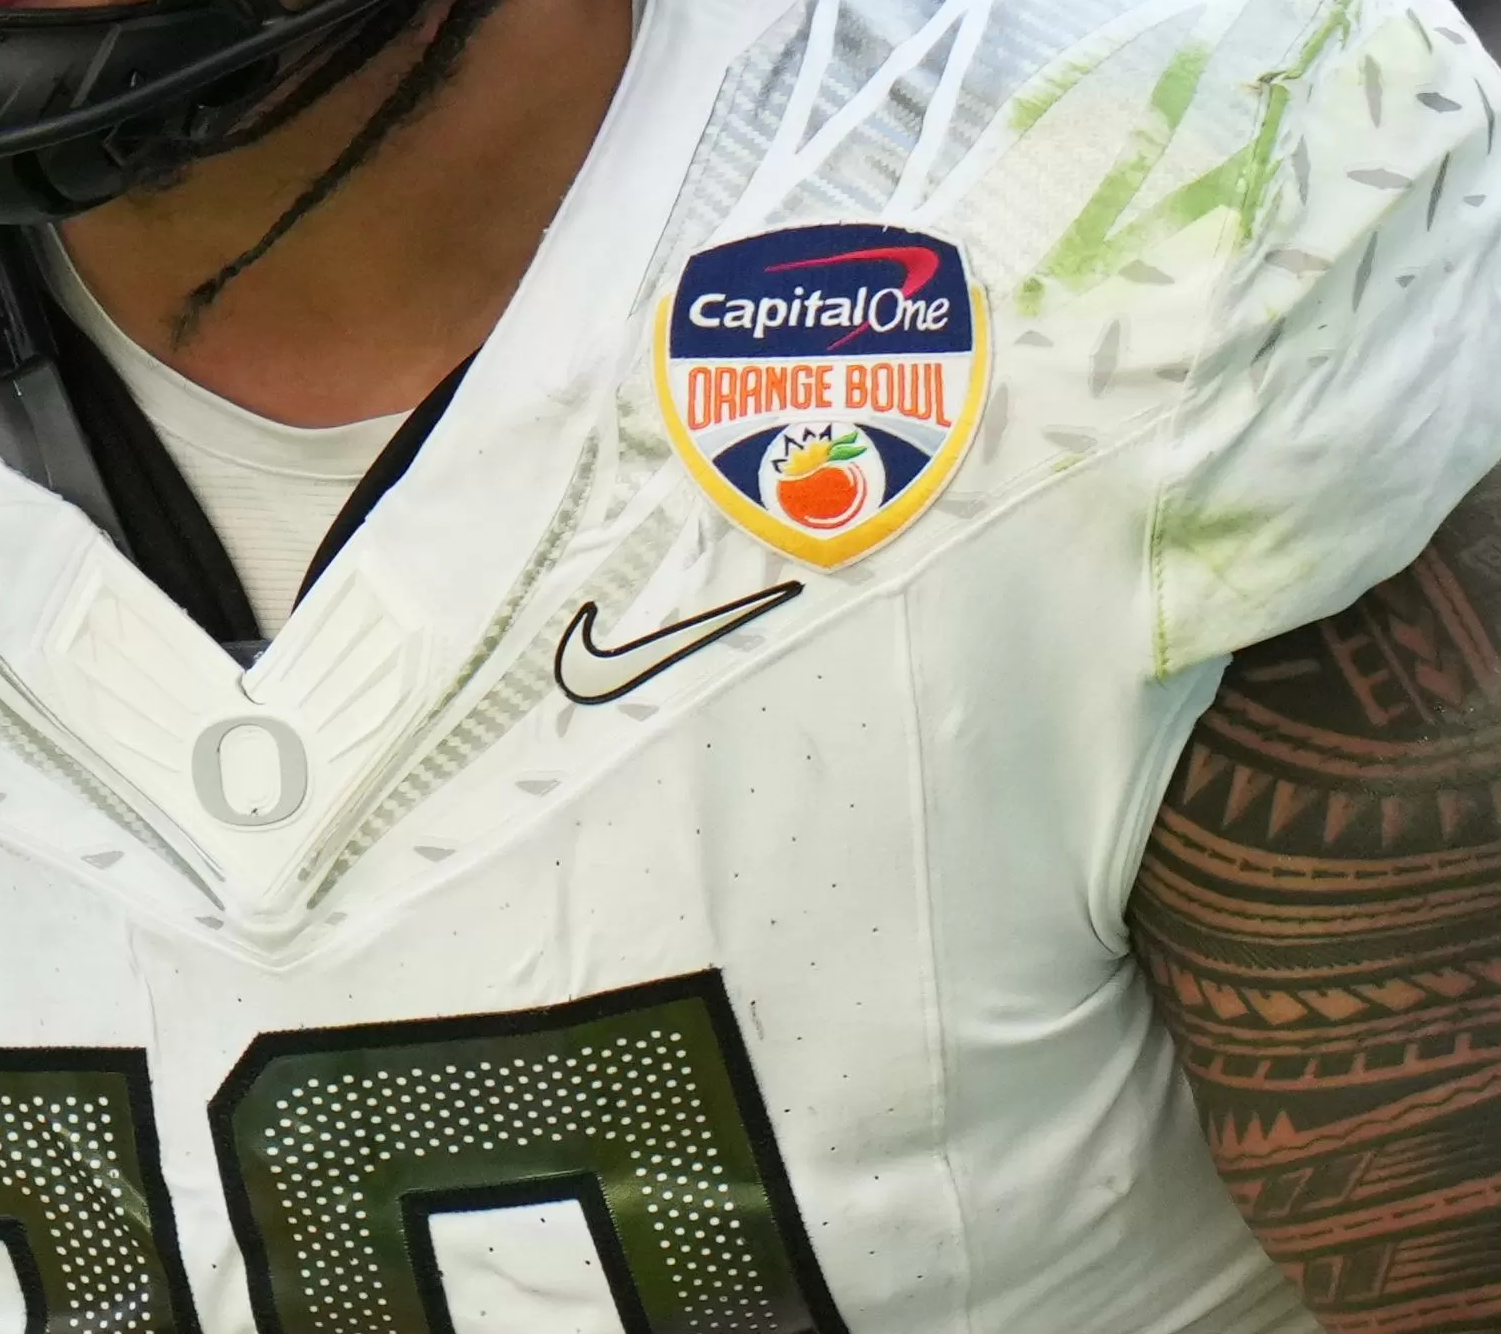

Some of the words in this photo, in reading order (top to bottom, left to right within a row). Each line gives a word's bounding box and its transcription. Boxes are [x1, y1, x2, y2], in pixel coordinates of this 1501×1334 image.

[687, 364, 832, 430] ORANGE
[846, 363, 951, 427] BOWL
[191, 715, 308, 827] O
